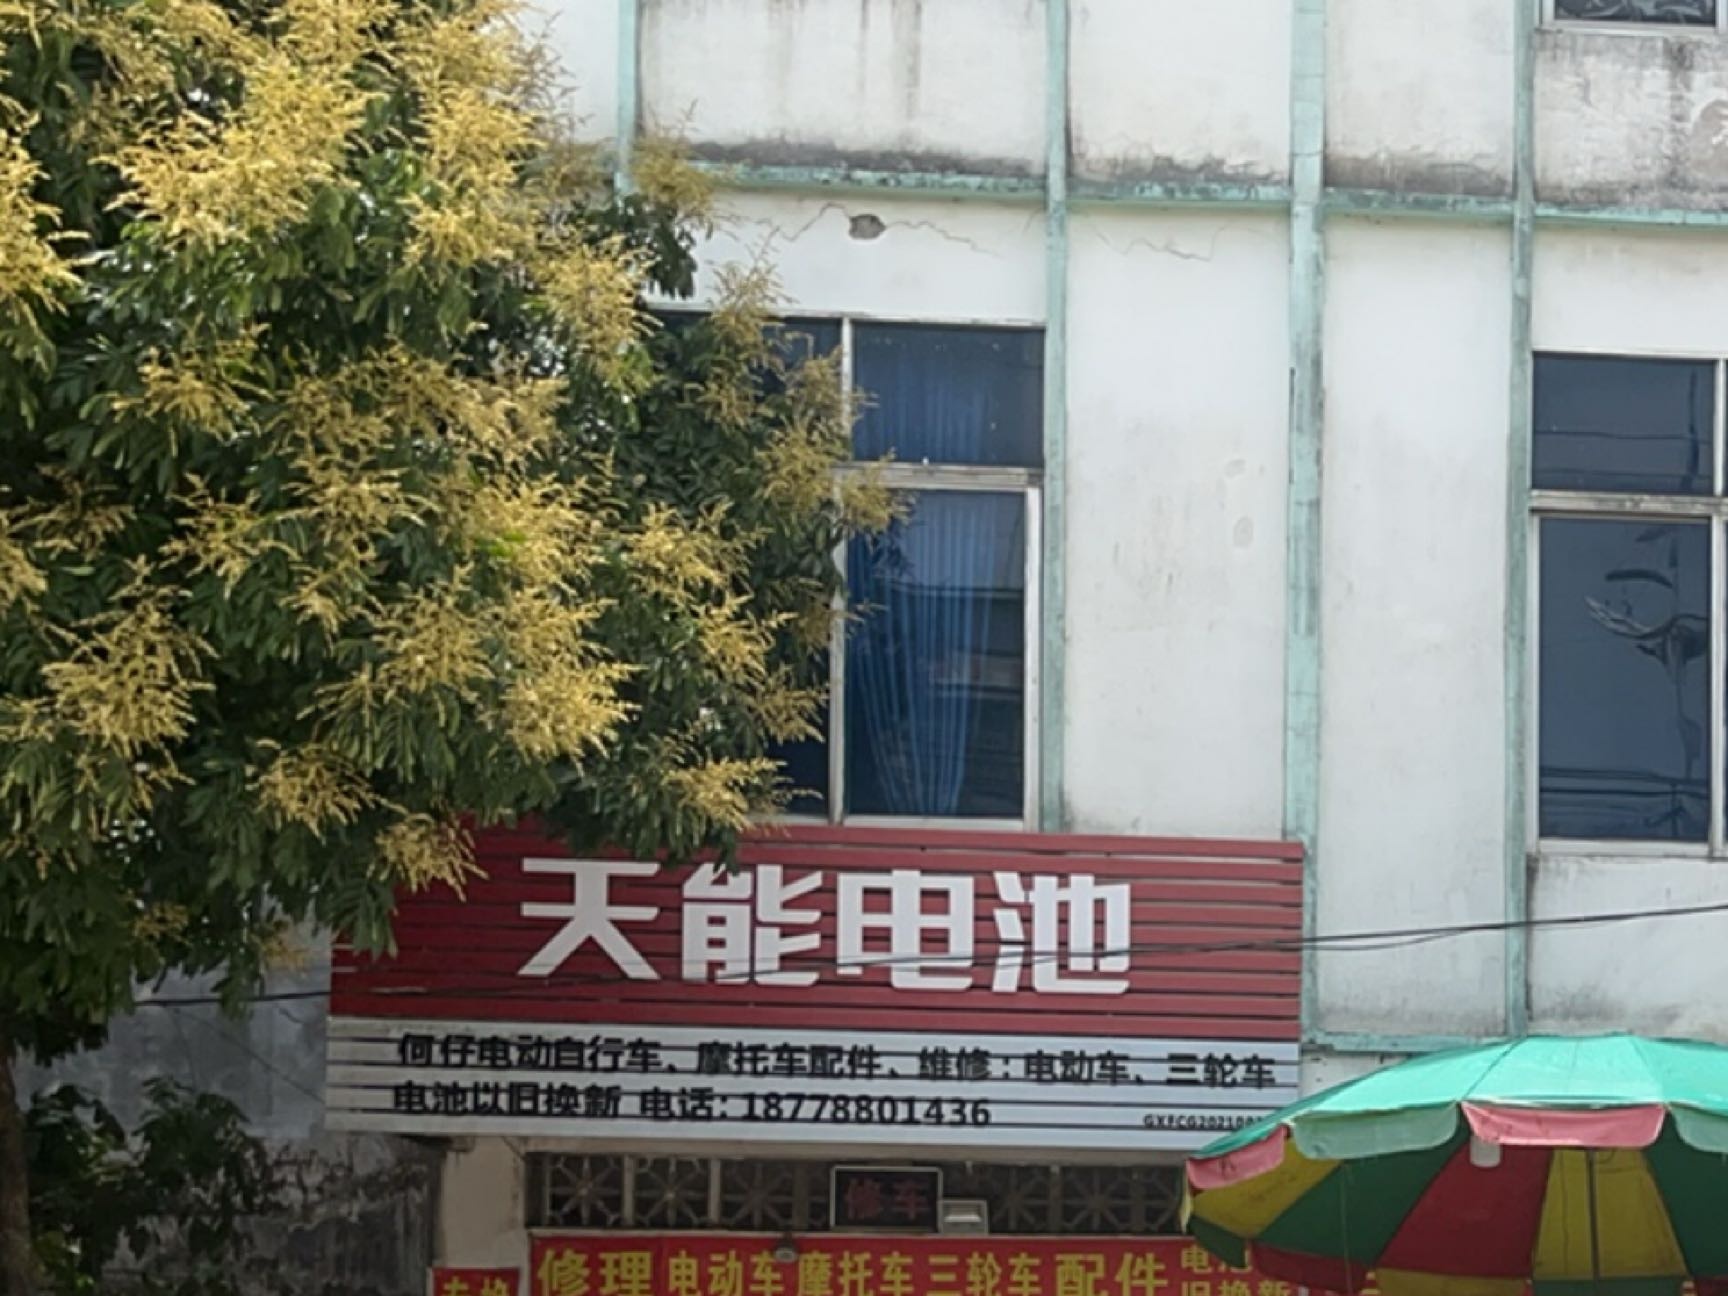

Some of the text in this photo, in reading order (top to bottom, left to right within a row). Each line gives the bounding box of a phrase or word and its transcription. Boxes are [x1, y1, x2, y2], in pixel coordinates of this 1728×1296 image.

[518, 857, 1131, 994] 天能电池
[393, 1080, 622, 1118] 电池以旧换新
